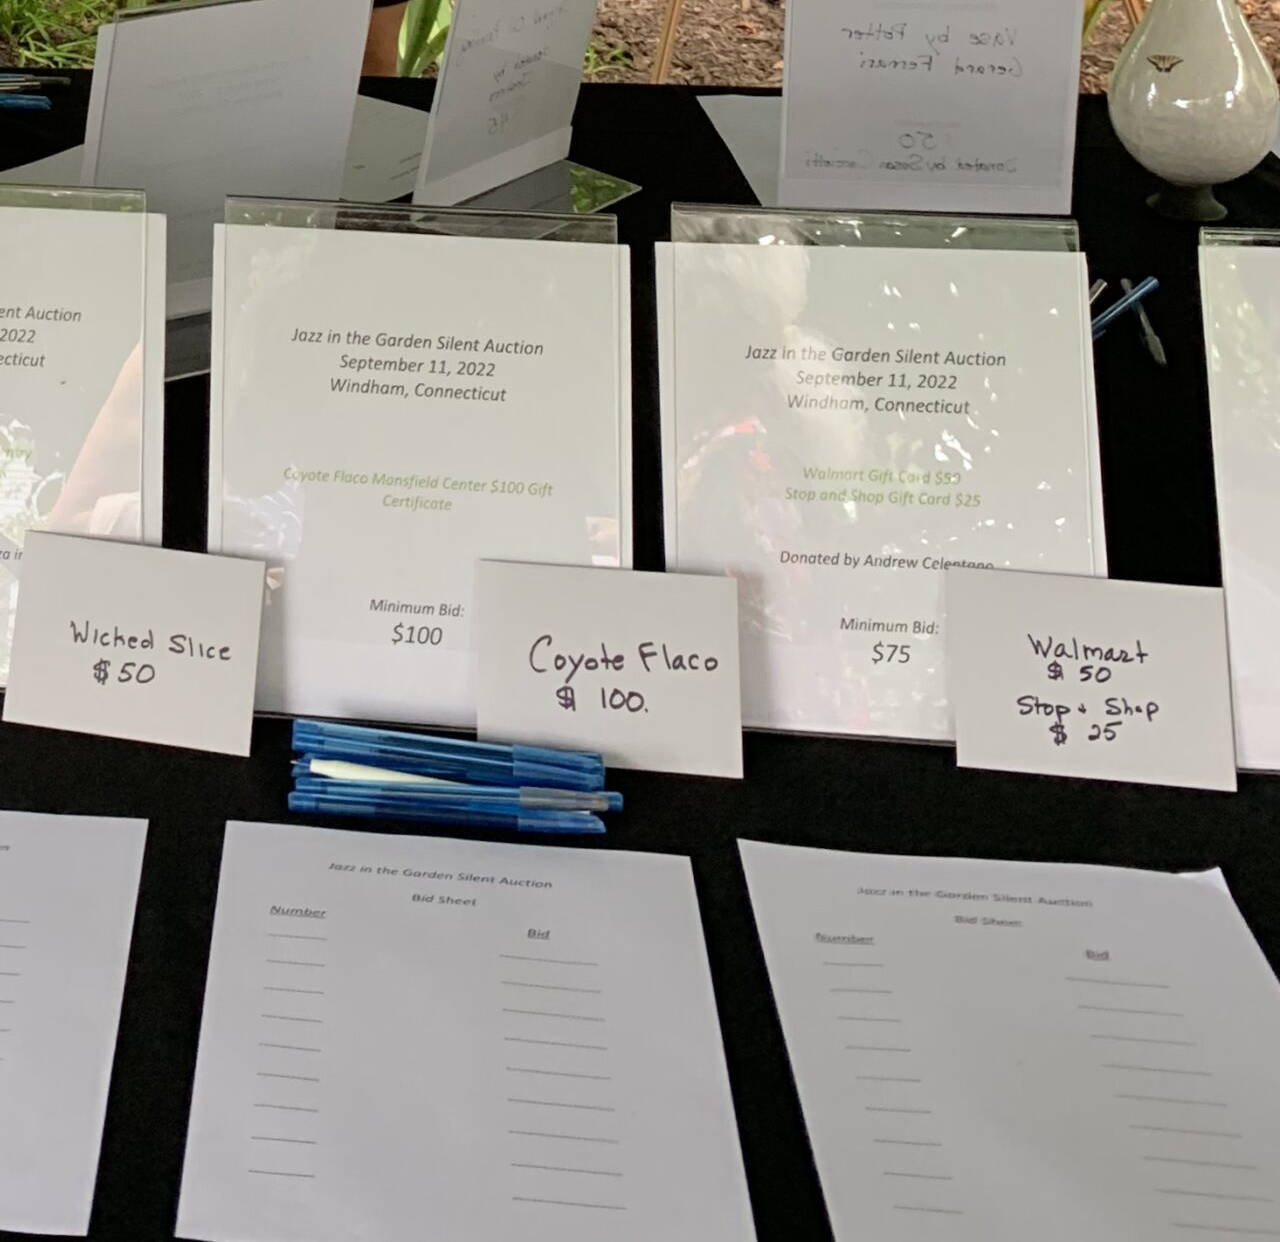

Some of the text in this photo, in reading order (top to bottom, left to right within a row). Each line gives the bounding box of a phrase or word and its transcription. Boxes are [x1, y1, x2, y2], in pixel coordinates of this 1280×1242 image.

[24, 306, 82, 322] Auction
[291, 328, 544, 355] Jazz in the Garden Silent Auction
[340, 354, 496, 377] September 11, 2022
[745, 345, 1006, 367] Jazz in the Garden Silent Auction
[330, 378, 506, 402] Windham, Connecticut
[797, 370, 957, 390] September 11, 2022
[787, 394, 970, 417] Windham, Connecticut
[282, 466, 554, 499] Coyote Flaco Mansfield Center $100 Gift
[803, 466, 864, 483] Walmart
[868, 468, 895, 485] Gift
[382, 494, 452, 512] Certificate
[784, 486, 982, 509] Stop and Shop Gift Card $25
[780, 550, 840, 566] Donated
[843, 552, 861, 569] by
[863, 554, 919, 569] Andrew
[369, 599, 464, 618] Minimum Bid:
[392, 622, 443, 646] $100
[840, 617, 939, 635] Minimum Bid:
[70, 620, 232, 661] Wicked Slice
[1027, 633, 1149, 664] Walmart
[529, 634, 719, 684] Coyote Flaco
[872, 641, 910, 664] $75
[1016, 695, 1072, 724] Stop
[1104, 697, 1161, 722] Shop
[328, 862, 553, 889] Jazz in the Garden Silent Auction
[411, 893, 476, 906] Bid Sheet
[268, 904, 551, 941] Number Bid
